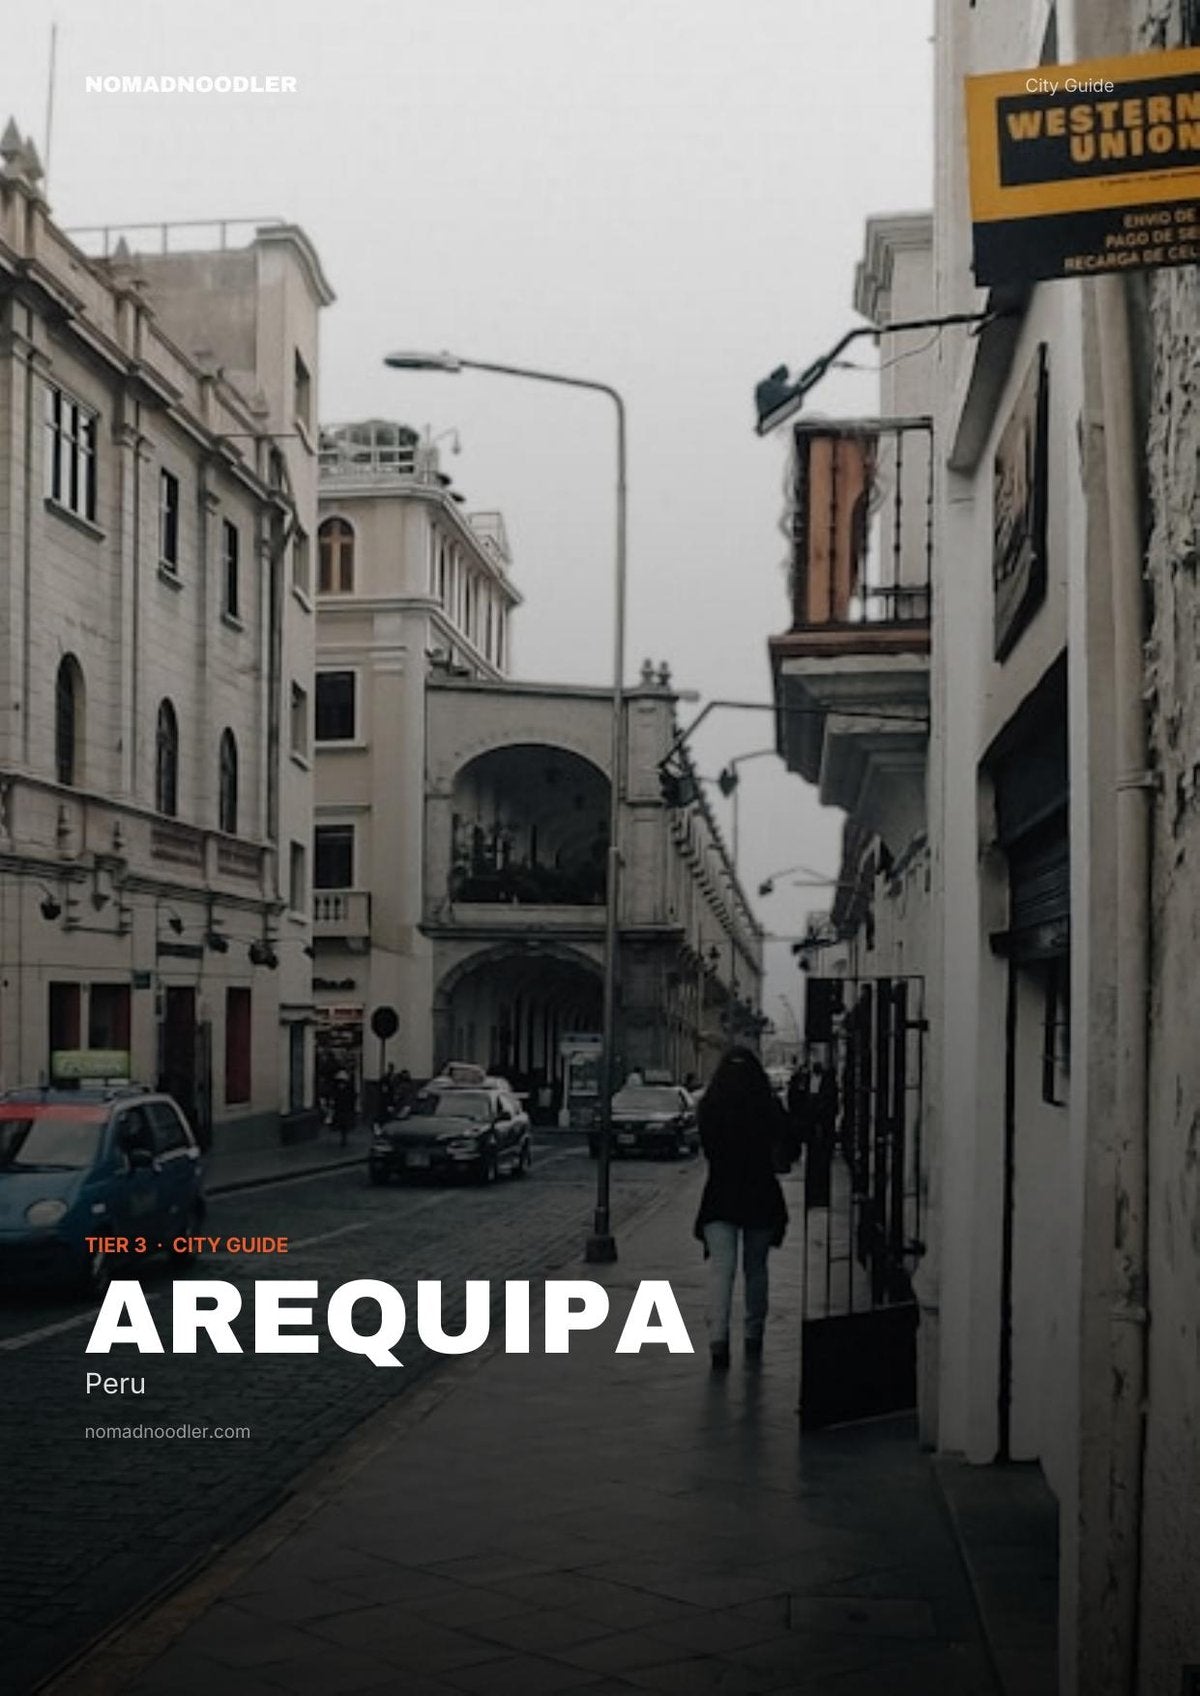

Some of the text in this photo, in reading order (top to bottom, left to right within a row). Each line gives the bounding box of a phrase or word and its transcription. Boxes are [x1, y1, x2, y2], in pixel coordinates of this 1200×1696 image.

[1006, 91, 1200, 141] WESTERN
[1069, 121, 1200, 163] UNION
[1174, 207, 1197, 223] DE
[1105, 230, 1150, 248] PAGO
[1152, 228, 1174, 244] DE
[1064, 250, 1140, 271] RECARGA
[1143, 246, 1165, 263] DE
